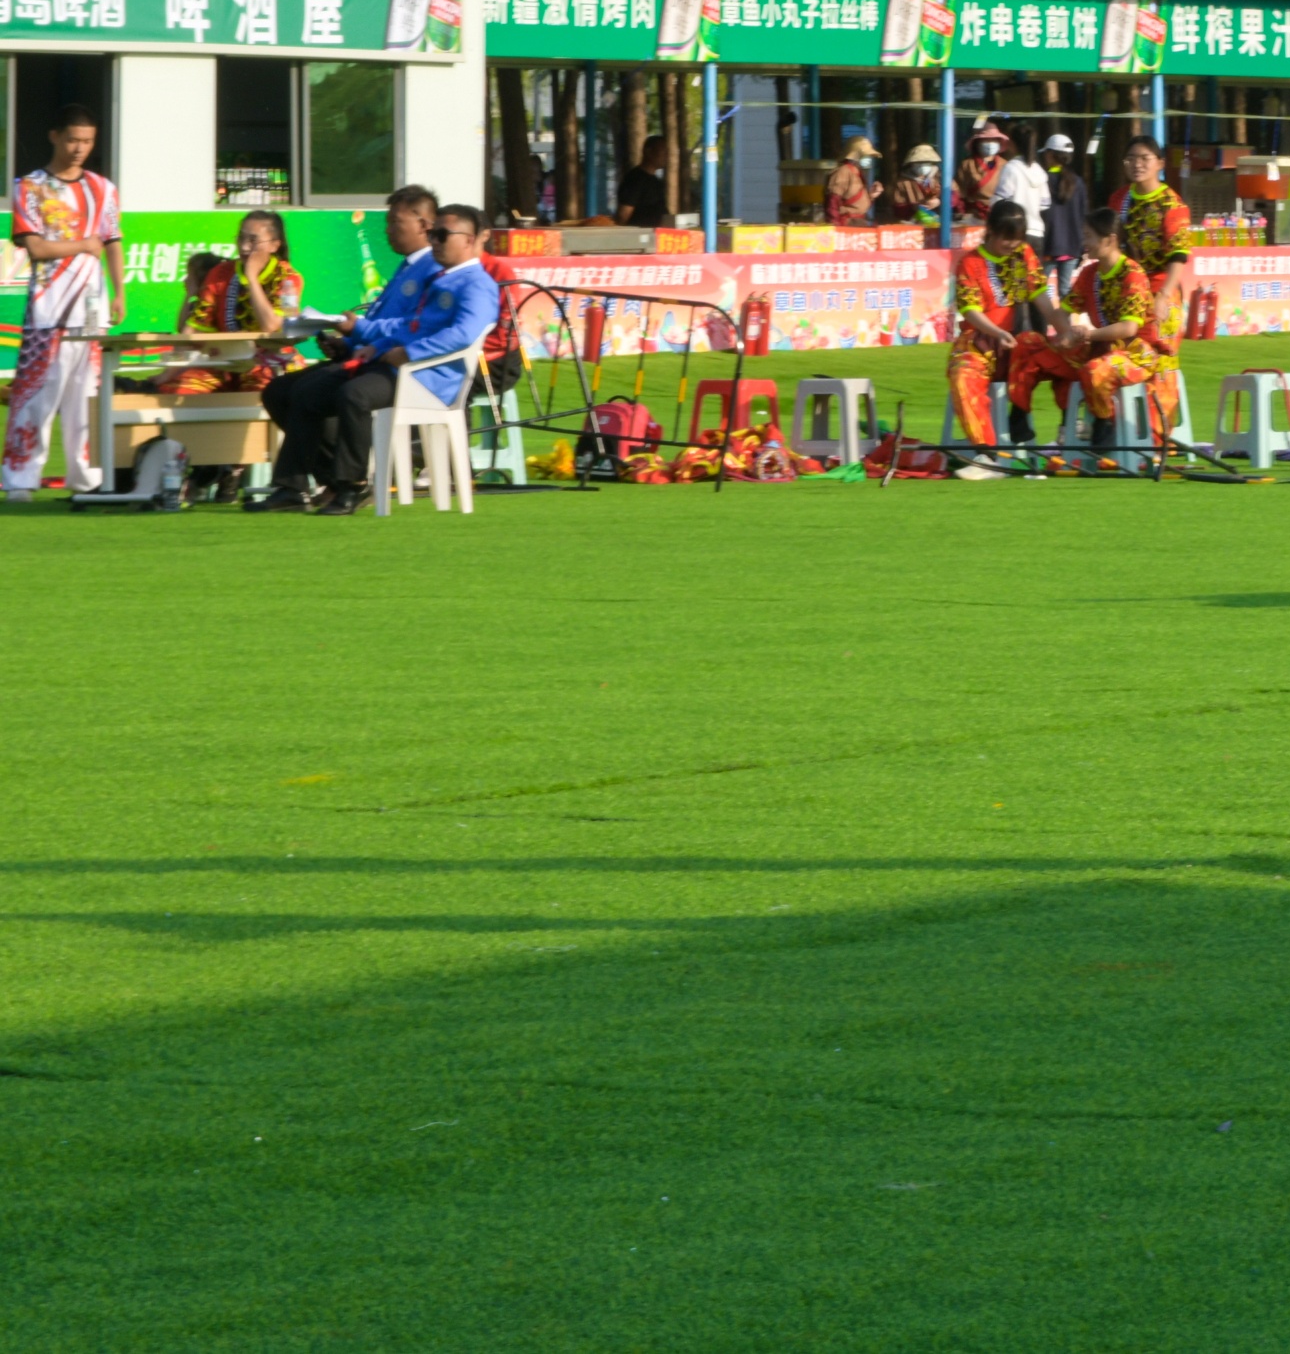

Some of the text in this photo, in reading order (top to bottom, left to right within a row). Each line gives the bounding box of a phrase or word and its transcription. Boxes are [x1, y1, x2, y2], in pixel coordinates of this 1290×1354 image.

[959, 1, 1098, 50] 炸串卷煎饼
[775, 289, 857, 312] 章鱼小丸子
